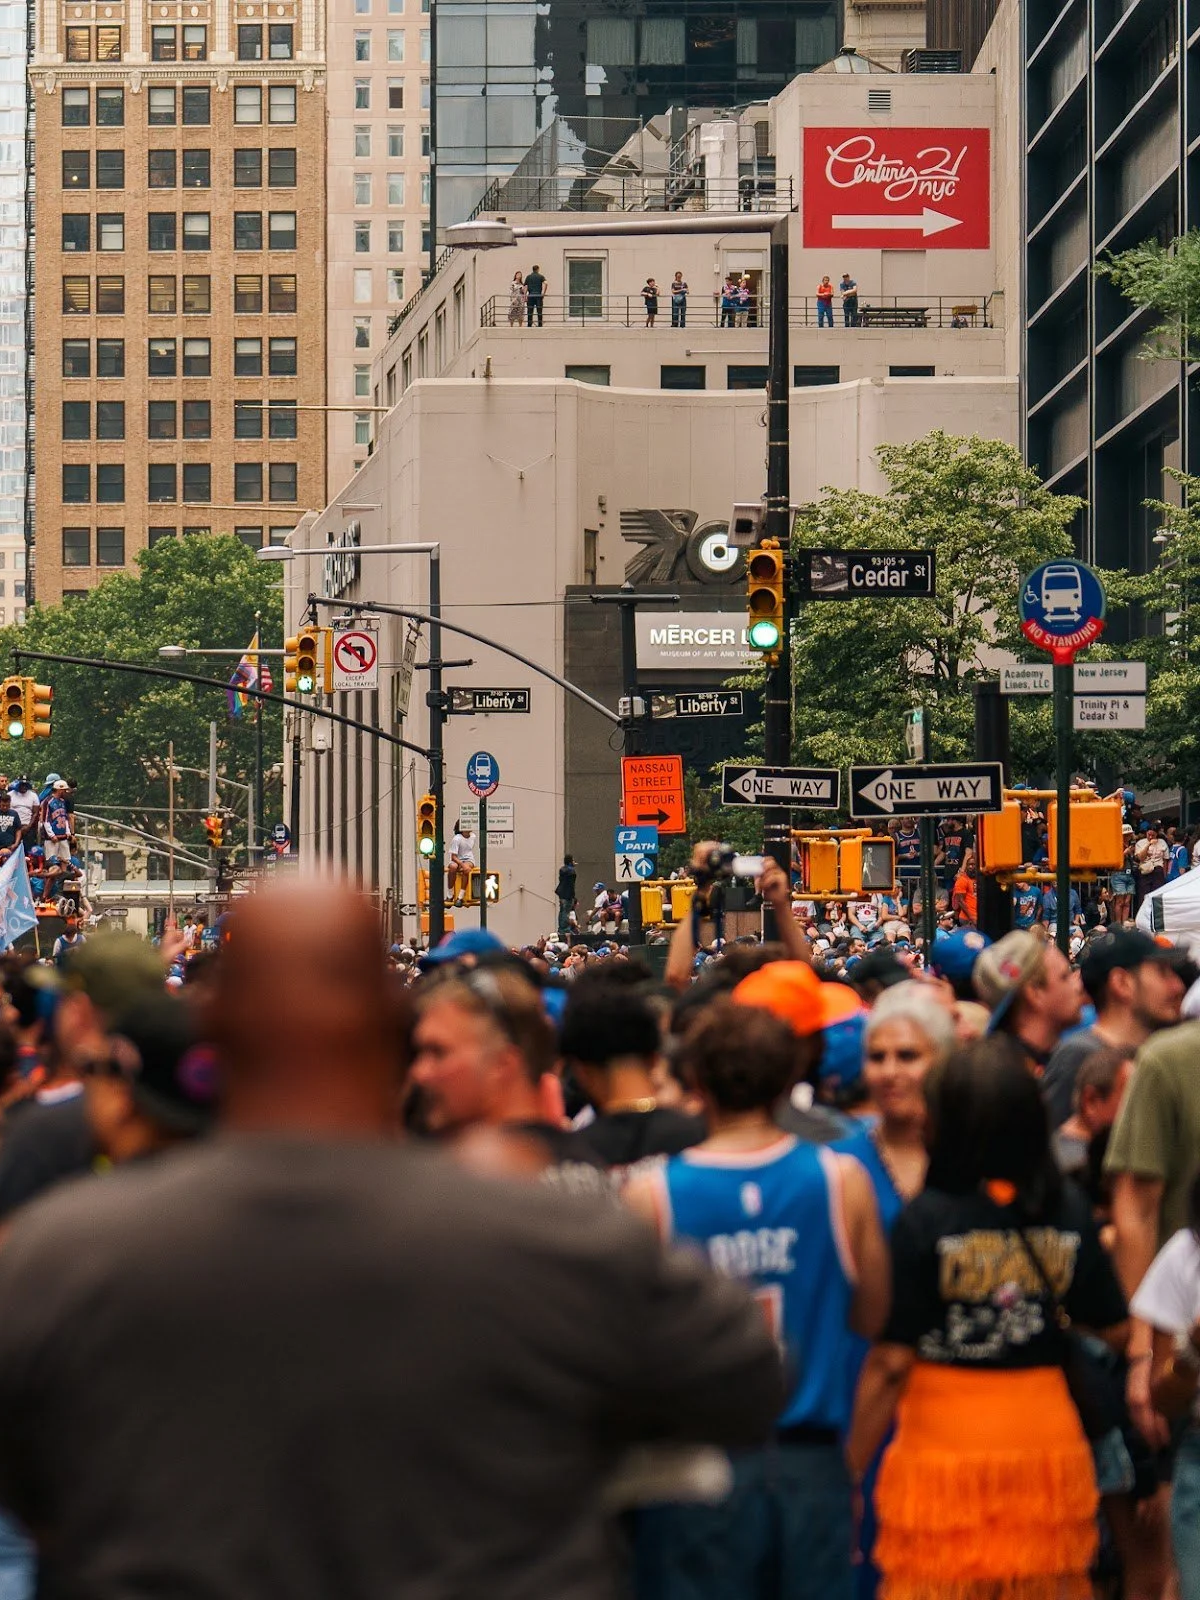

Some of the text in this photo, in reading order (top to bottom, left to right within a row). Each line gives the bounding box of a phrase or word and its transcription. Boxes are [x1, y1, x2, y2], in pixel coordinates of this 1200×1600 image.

[825, 135, 968, 202] Century 21
[918, 179, 956, 202] nyc
[871, 557, 897, 566] 93-105
[851, 564, 926, 587] Cedar St
[1027, 621, 1098, 648] NO STANDING
[1004, 669, 1043, 679] Academy
[1078, 668, 1128, 678] New Jersey
[1004, 679, 1050, 690] Lines, LLC
[475, 695, 515, 710] Liberty
[679, 697, 738, 715] Liberty St
[1079, 700, 1108, 711] Trinity
[1123, 700, 1130, 709] &
[1079, 712, 1119, 721] Cedar St
[630, 763, 673, 773] NASSAU
[468, 782, 476, 791] NO
[632, 776, 672, 787] STREET
[741, 778, 824, 796] ONE WAY
[875, 779, 981, 801] ONE WAY
[632, 795, 675, 805] DETOUR
[625, 842, 655, 850] PATH
